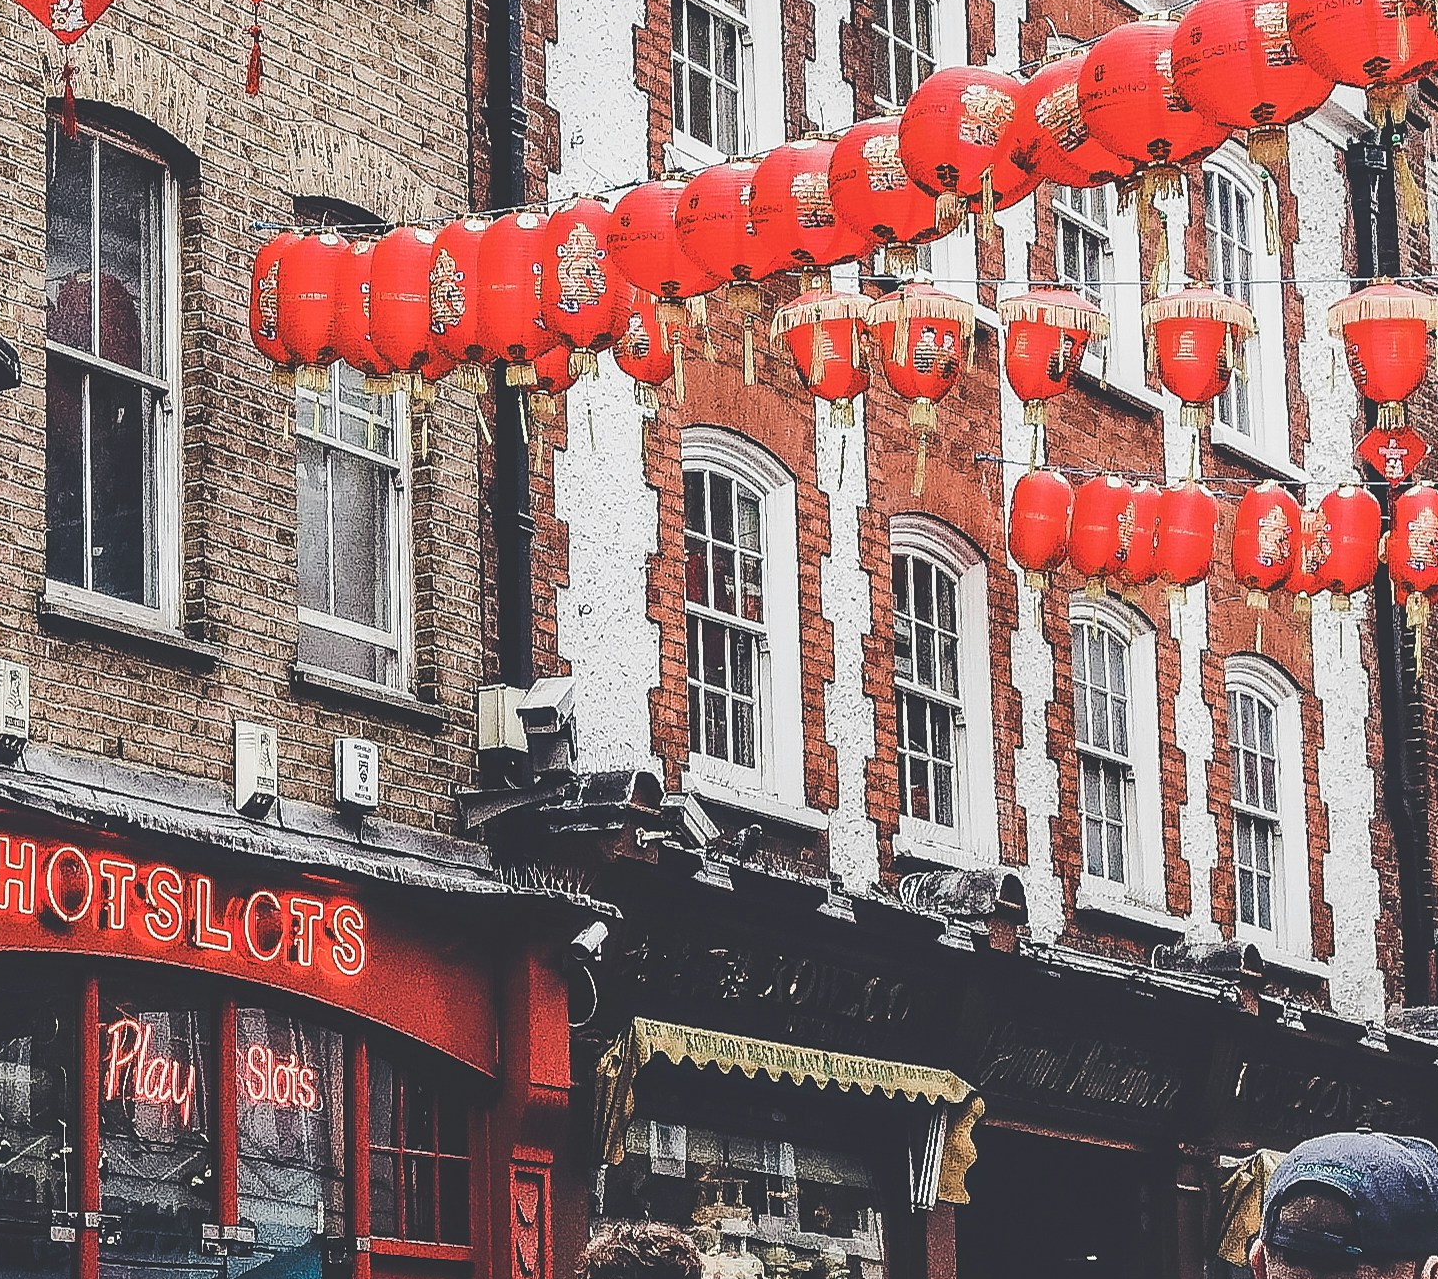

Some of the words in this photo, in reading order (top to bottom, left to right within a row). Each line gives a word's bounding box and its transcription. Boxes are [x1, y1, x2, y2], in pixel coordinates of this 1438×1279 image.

[102, 1017, 197, 1127] Play
[244, 1045, 318, 1112] Slots
[686, 1031, 745, 1060] KOWLOON
[746, 1042, 822, 1072] RESTAURANT
